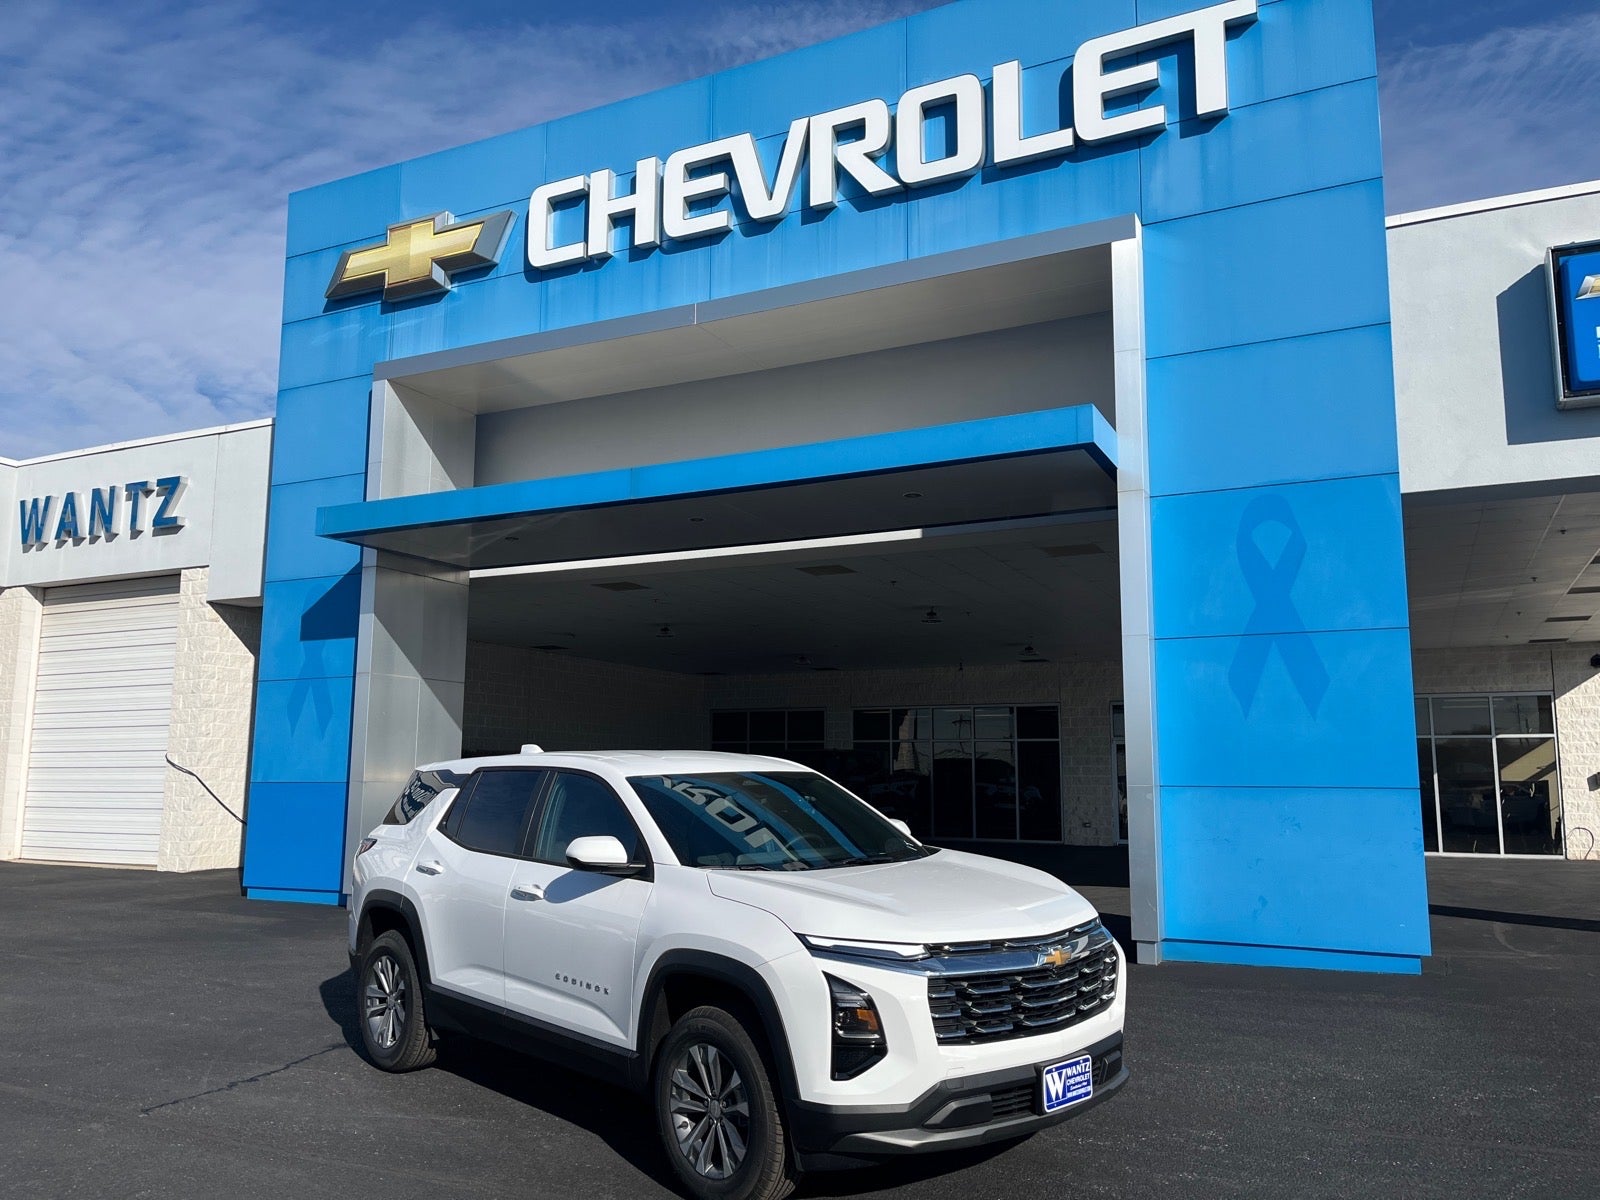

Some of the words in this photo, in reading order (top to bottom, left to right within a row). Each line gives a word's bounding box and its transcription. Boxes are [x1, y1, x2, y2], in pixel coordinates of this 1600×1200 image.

[526, 0, 1257, 270] CHEVROLET
[20, 475, 186, 551] WANTZ
[1046, 1069, 1066, 1102] W
[1067, 1062, 1090, 1077] WANTZ
